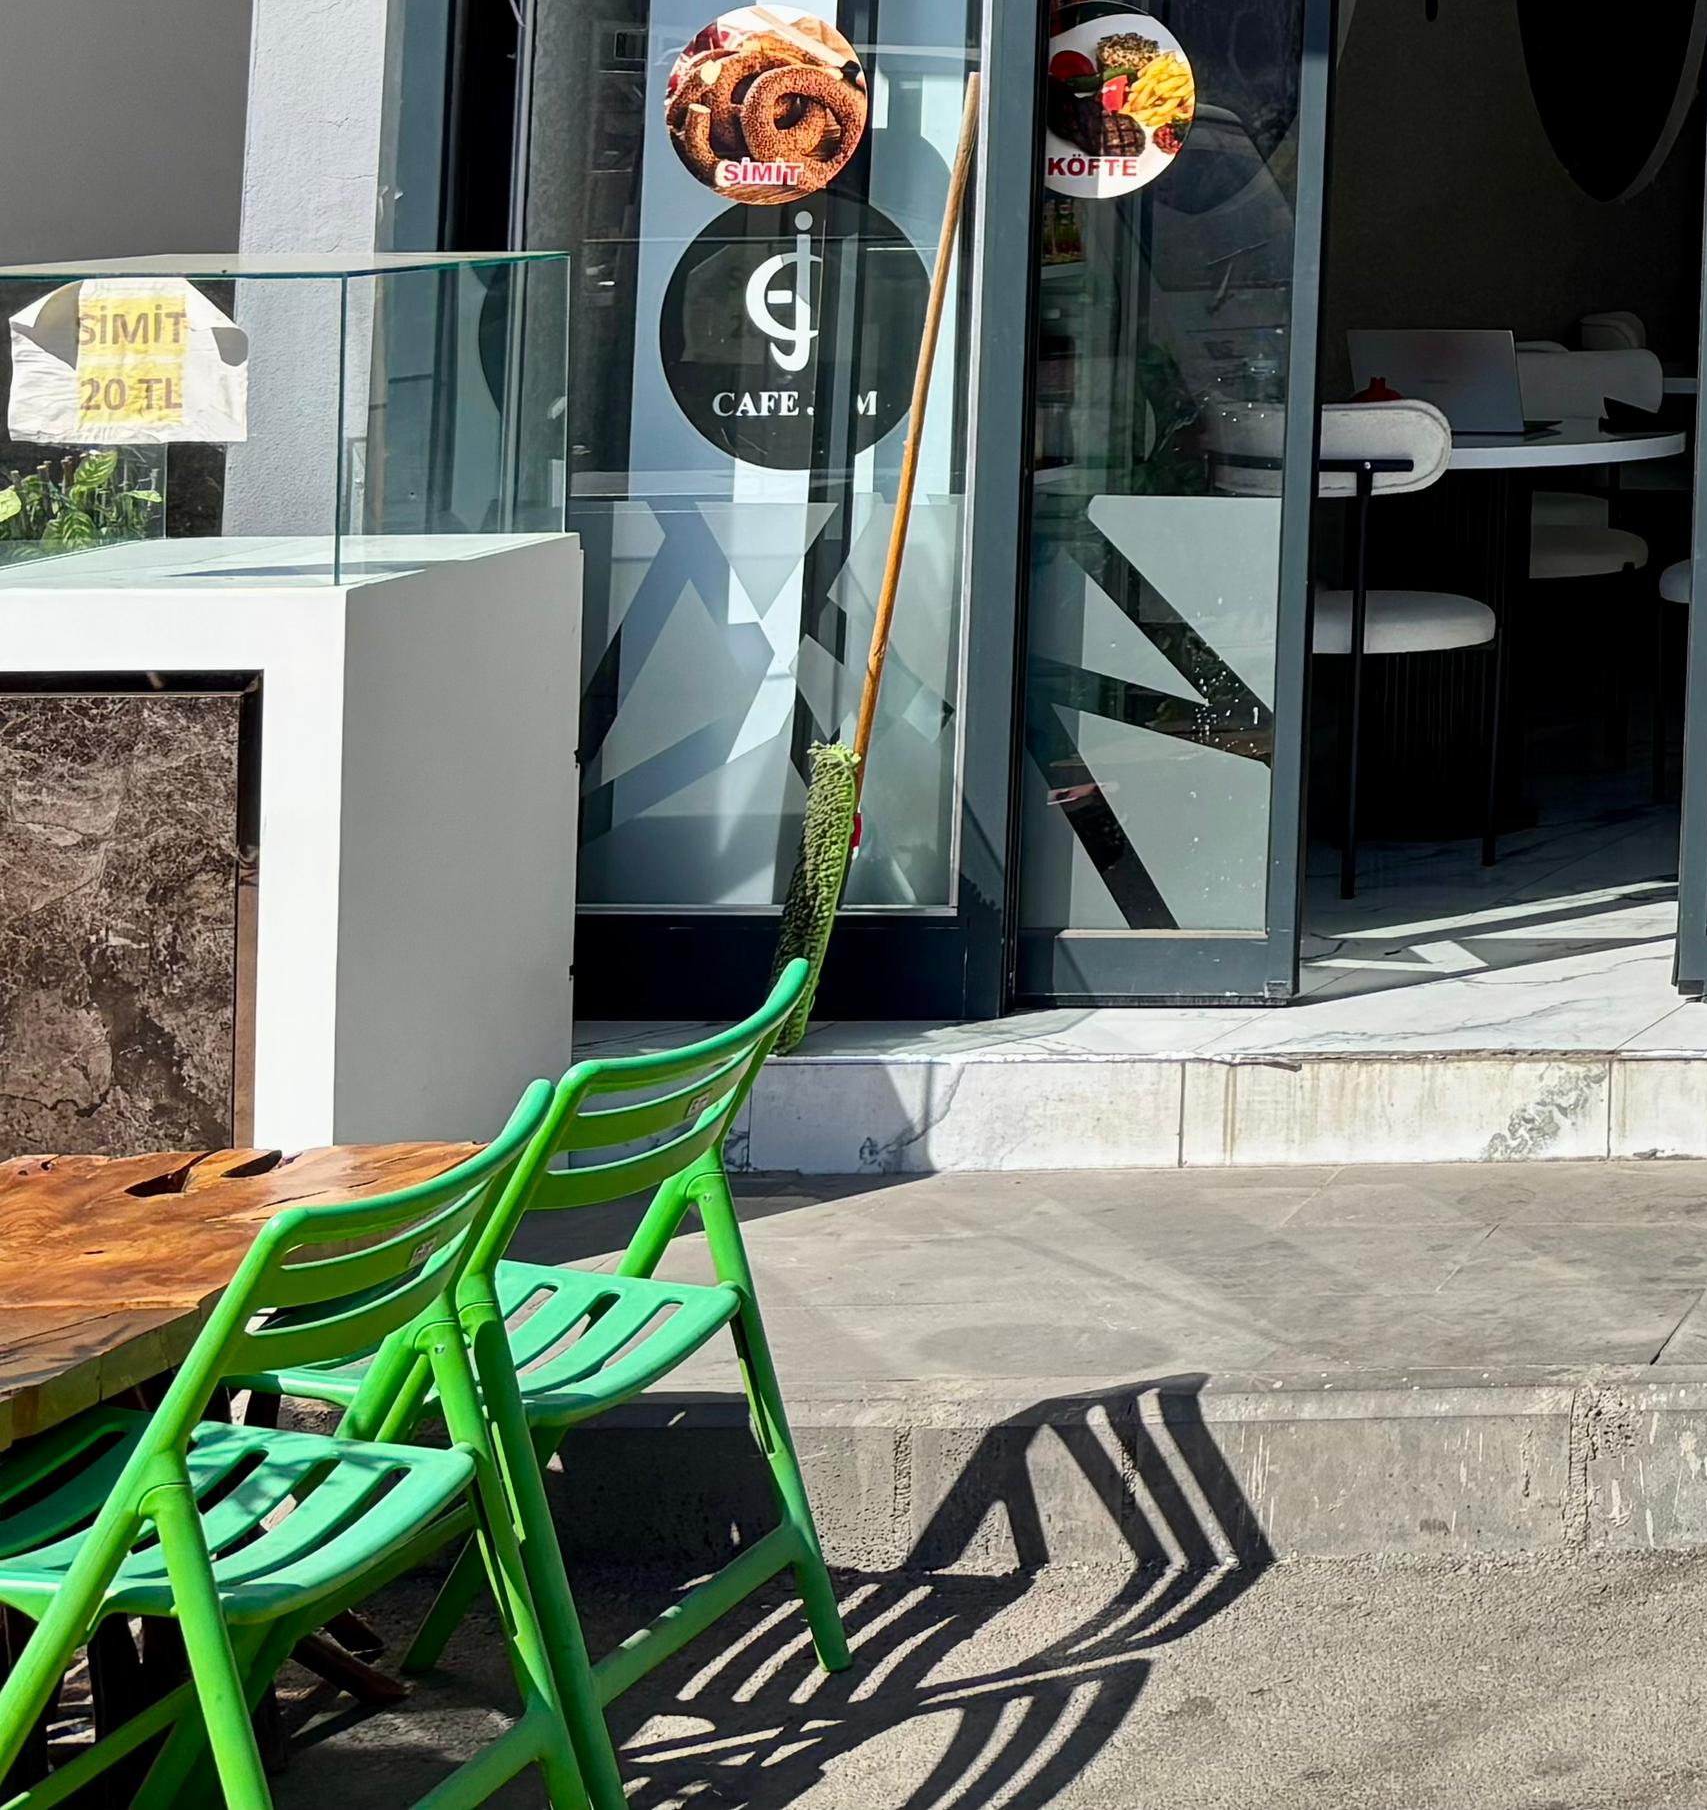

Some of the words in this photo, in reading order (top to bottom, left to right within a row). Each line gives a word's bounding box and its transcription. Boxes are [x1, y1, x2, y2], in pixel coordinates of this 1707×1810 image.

[1047, 153, 1137, 177] KÖFTE
[78, 305, 187, 346] SİMİT
[80, 377, 127, 411] 20
[137, 377, 183, 411] TL
[712, 390, 800, 417] CAFE
